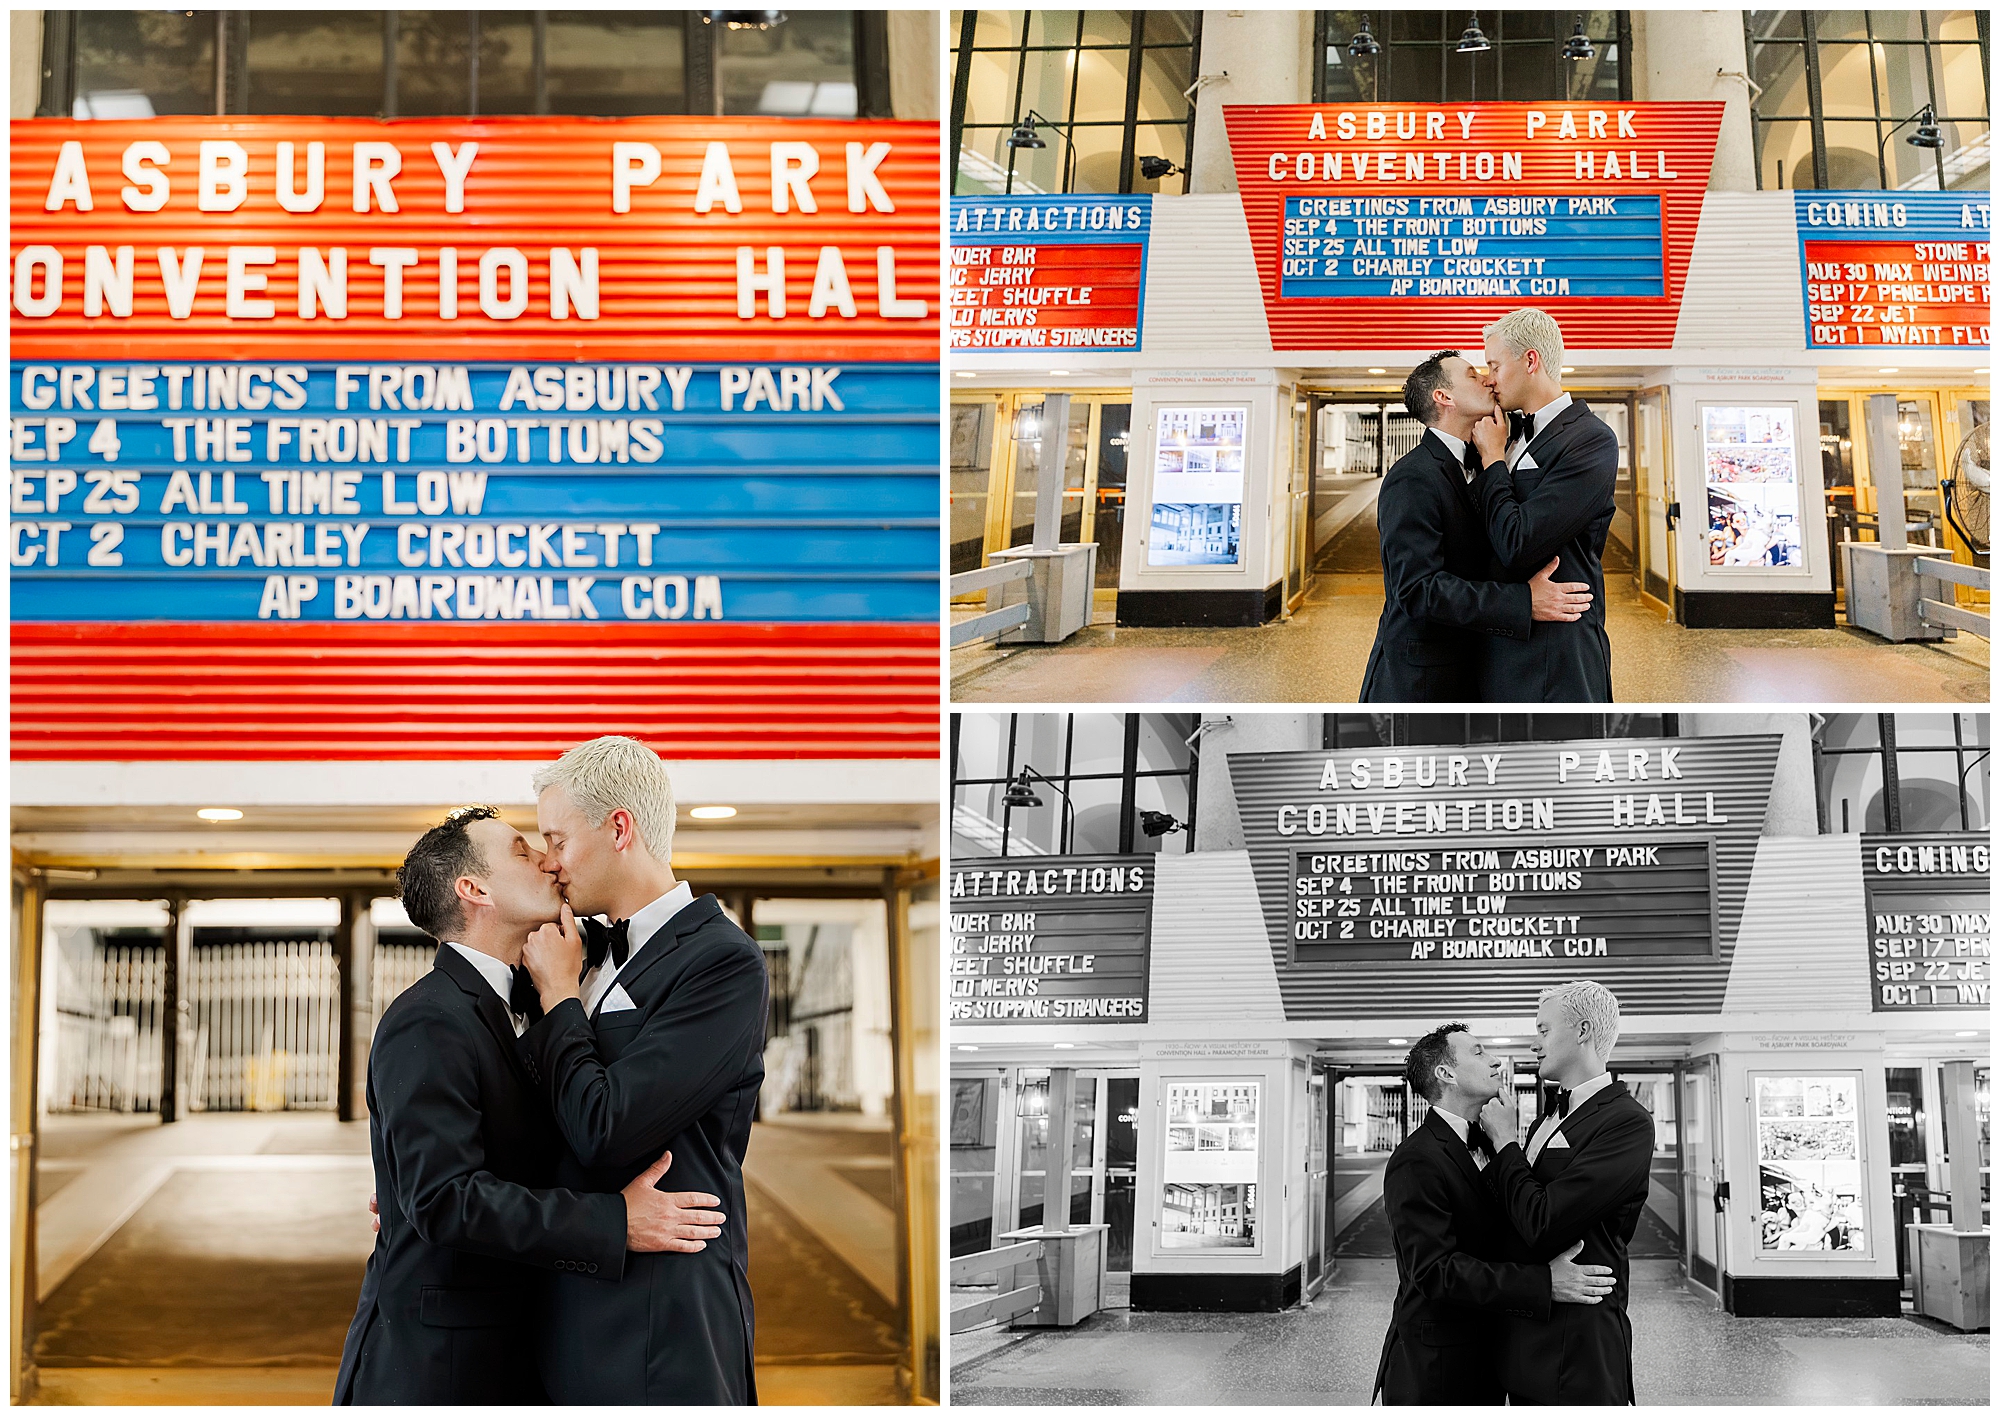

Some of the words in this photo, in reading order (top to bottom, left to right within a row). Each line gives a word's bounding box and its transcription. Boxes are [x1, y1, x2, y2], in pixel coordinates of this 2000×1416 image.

[1308, 111, 1476, 140] ASBURY
[1527, 110, 1637, 139] PARK
[1268, 152, 1523, 180] CONVENTION
[1575, 150, 1677, 179] HALL
[45, 141, 480, 213] ASBURY
[612, 142, 896, 213] PARK
[1299, 199, 1408, 215] GREETINGS
[1420, 199, 1473, 215] FROM
[1484, 199, 1558, 215] ASBURY
[1569, 198, 1617, 214] PARK
[1808, 203, 1907, 227] COMING
[956, 206, 1141, 231] ATTRACTIONS
[1285, 219, 1319, 236] SEP
[1325, 219, 1337, 236] 4
[1353, 219, 1387, 235] THE
[1393, 219, 1452, 235] FRONT
[1462, 218, 1546, 235] BOTTOMS
[1285, 239, 1319, 255] SEP
[1323, 239, 1345, 255] 25
[1353, 239, 1386, 255] ALL
[1391, 239, 1429, 255] TIME
[1437, 238, 1478, 255] LOW
[1915, 244, 1967, 260] STONE
[1002, 248, 1036, 265] BAR
[979, 267, 1034, 285] JERRY
[1283, 259, 1314, 275] OCT
[1325, 259, 1338, 275] 2
[1353, 259, 1433, 275] CHARLEY
[1443, 258, 1545, 275] CROCKETT
[1808, 264, 1841, 281] AUG
[1844, 264, 1867, 281] 30
[1874, 264, 1914, 281] MAX
[13, 245, 599, 320] ONVENTION
[736, 246, 928, 318] HAL
[1391, 280, 1414, 296] AP
[1420, 280, 1521, 296] BOARDWALK
[1003, 287, 1092, 305] SHUFFLE
[1808, 284, 1844, 302] SEP
[1849, 284, 1869, 302] 17
[1878, 284, 1975, 302] PENELOPE
[979, 308, 1037, 326] MERVS
[1809, 305, 1844, 322] SEP
[1851, 305, 1874, 322] 22
[1880, 305, 1918, 322] JET
[1050, 328, 1137, 346] STRANGERS
[1815, 325, 1848, 343] OCT
[1856, 326, 1864, 344] 1
[1880, 325, 1942, 343] WYATT
[21, 366, 308, 410] GREETINGS
[335, 366, 474, 410] FROM
[500, 366, 693, 411] ASBURY
[720, 366, 845, 411] PARK
[11, 418, 76, 461] EP
[88, 418, 121, 462] 4
[162, 418, 253, 462] THE
[267, 418, 422, 463] FRONT
[447, 418, 664, 463] BOTTOMS
[11, 470, 77, 513] EP
[84, 470, 141, 513] 25
[160, 470, 248, 514] ALL
[261, 470, 363, 514] TIME
[382, 470, 487, 515] LOW
[88, 522, 124, 566] 2
[161, 522, 370, 567] CHARLEY
[398, 523, 660, 567] CROCKETT
[258, 575, 318, 619] AP
[334, 575, 599, 619] BOARDWALK
[622, 575, 723, 619] COM
[1319, 754, 1502, 790] ASBURY
[1559, 747, 1682, 783] PARK
[1277, 798, 1554, 836] CONVENTION
[1612, 792, 1728, 827] HALL
[1311, 852, 1430, 874] GREETINGS
[1441, 851, 1500, 871] FROM
[1511, 848, 1594, 870] ASBURY
[1606, 847, 1660, 867] PARK
[1876, 845, 1989, 872] COMING
[952, 867, 1144, 897] ATTRACTIONS
[1296, 877, 1334, 896] SEP
[1339, 876, 1352, 895] 4
[1370, 875, 1407, 895] THE
[1413, 873, 1479, 894] FRONT
[1488, 871, 1582, 893] BOTTOMS
[1296, 899, 1334, 918] SEP
[1337, 898, 1361, 917] 25
[1369, 897, 1406, 917] ALL
[1412, 896, 1454, 916] TIME
[1462, 895, 1507, 914] LOW
[1001, 913, 1036, 931] BAR
[1295, 921, 1332, 940] OCT
[1340, 920, 1355, 940] 2
[1369, 918, 1457, 939] CHARLEY
[1468, 917, 1581, 937] CROCKETT
[1875, 915, 1914, 934] AUG
[1916, 915, 1943, 934] 30
[979, 934, 1035, 953] JERRY
[1410, 941, 1435, 960] AP
[1442, 939, 1554, 959] BOARDWALK
[1875, 939, 1916, 957] SEP
[1922, 939, 1945, 957] 17
[1003, 955, 1095, 975] SHUFFLE
[1877, 962, 1916, 981] SEP
[1924, 962, 1949, 981] 22
[981, 978, 1039, 996] MERVS
[1882, 985, 1919, 1004] OCT
[1930, 986, 1938, 1004] 1
[1053, 998, 1143, 1017] STRANGERS
[1229, 1040, 1252, 1048] HISTORY
[1820, 1033, 1845, 1041] HISTORY
